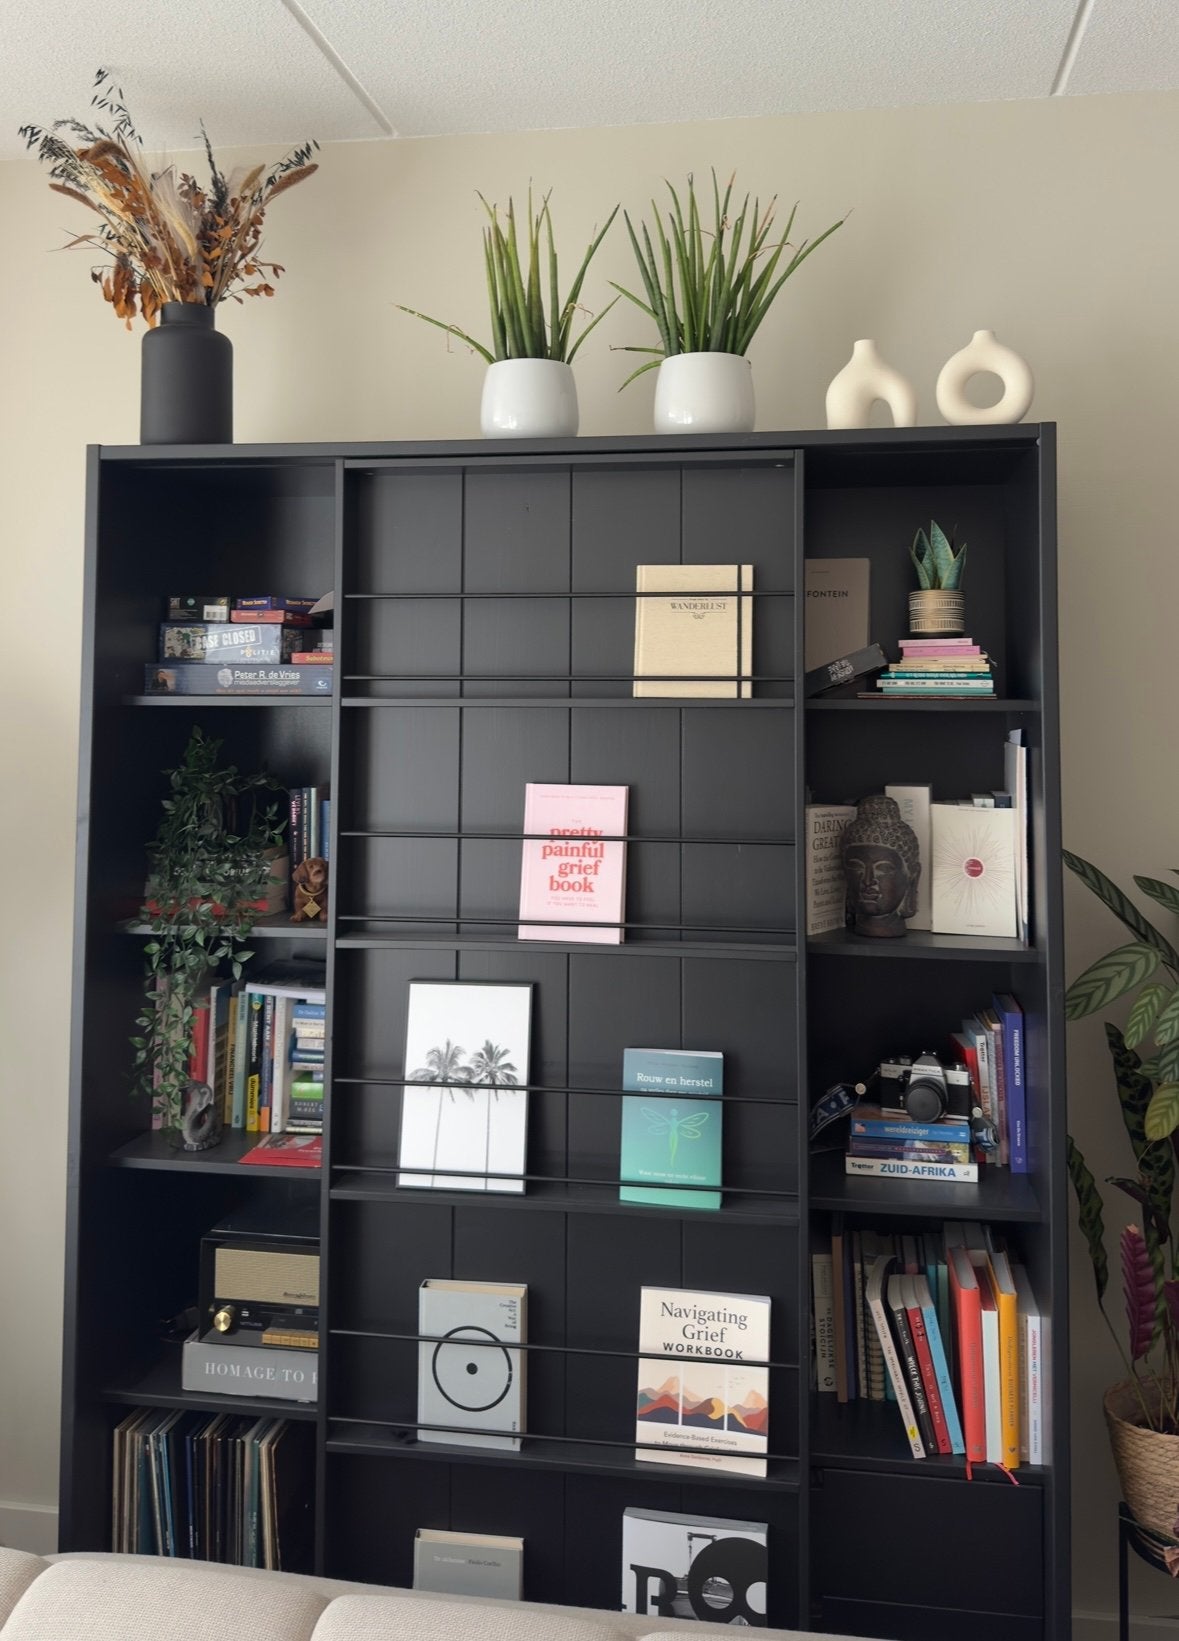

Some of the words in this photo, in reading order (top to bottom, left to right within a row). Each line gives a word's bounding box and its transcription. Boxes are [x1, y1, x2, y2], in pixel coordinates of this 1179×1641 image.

[807, 590, 849, 598] FONTEIN
[670, 602, 726, 610] WANDERLUST
[222, 629, 256, 645] CLOSED
[234, 670, 257, 679] Peter
[268, 670, 278, 679] de
[278, 670, 301, 679] Vries
[541, 842, 605, 860] painful
[558, 859, 602, 878] grief
[549, 876, 594, 893] book
[636, 1072, 662, 1084] Rouw
[665, 1076, 677, 1085] en
[680, 1076, 714, 1088] herstel
[880, 1163, 956, 1178] ZUID-AFRIKA
[660, 1302, 748, 1330] Navigating
[682, 1324, 728, 1344] Grief
[826, 1316, 834, 1368] DAGELIJKSE
[662, 1342, 744, 1360] WORKBOOK
[204, 1362, 276, 1381] HOMAGE
[282, 1368, 304, 1383] TO
[664, 1431, 709, 1443] Evidence-Based
[710, 1436, 738, 1446] Exercises
